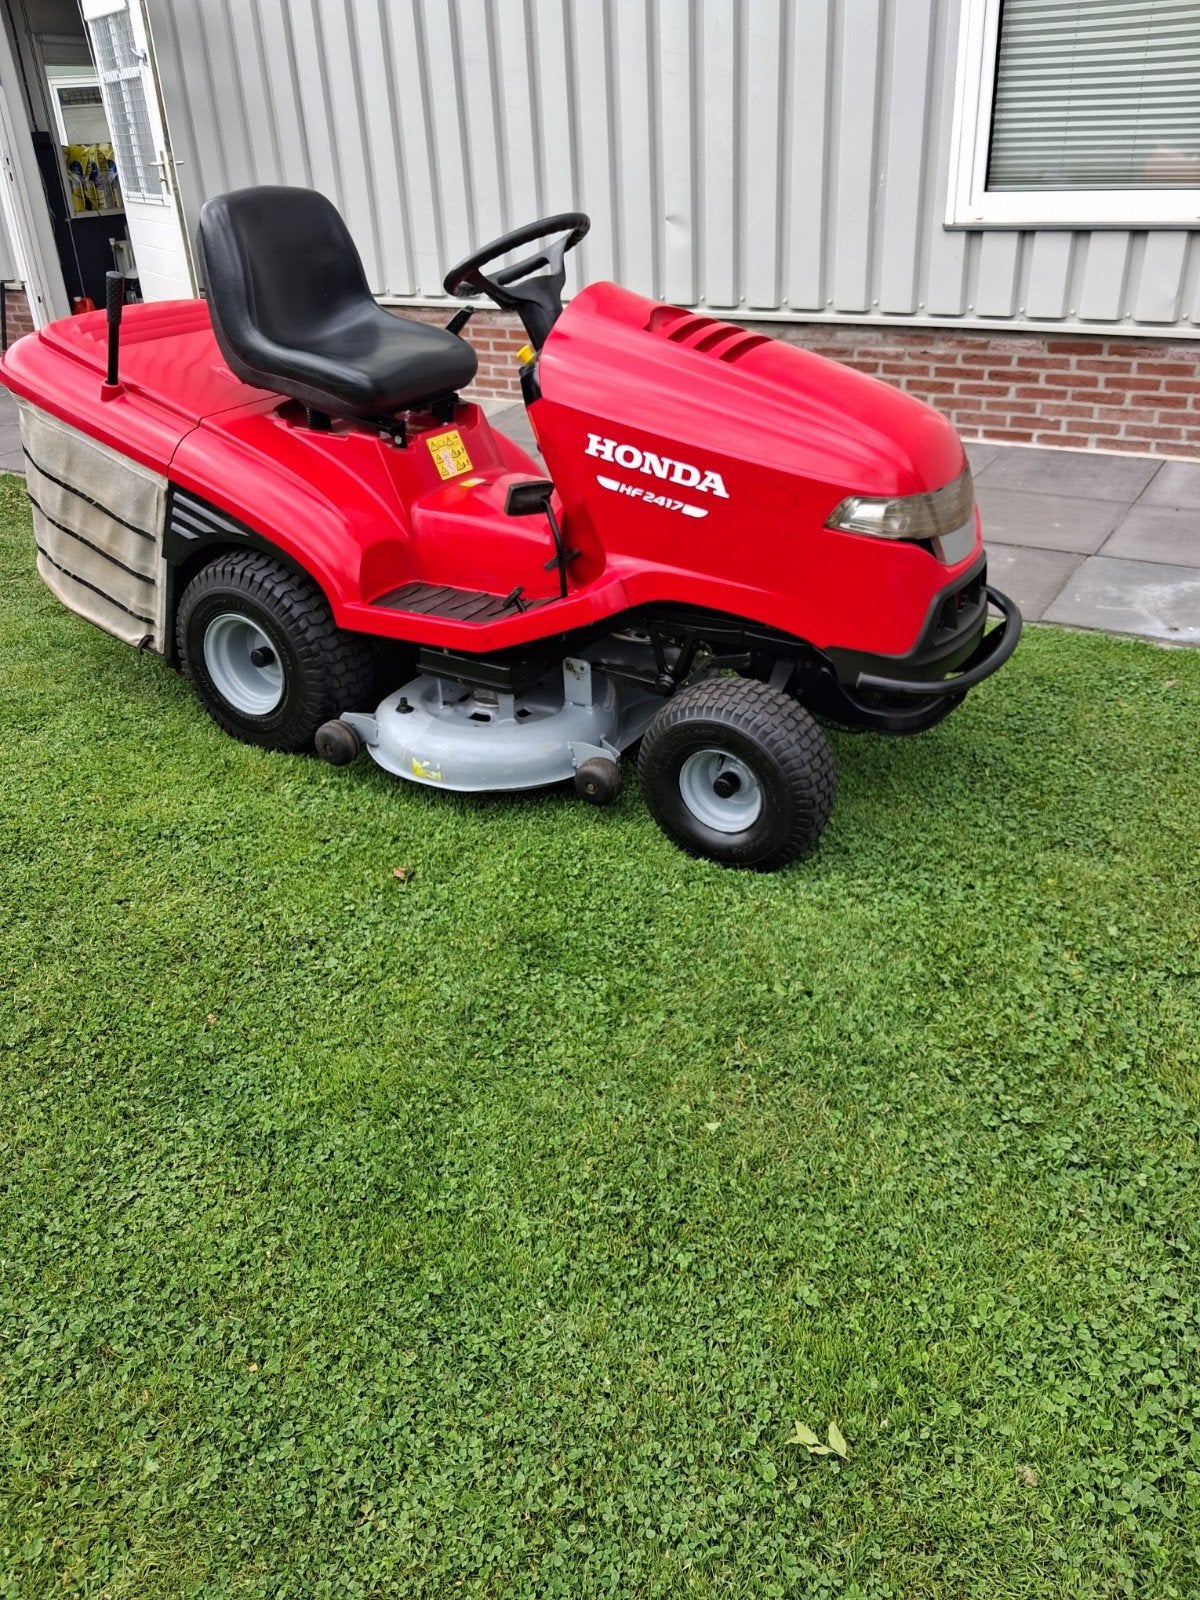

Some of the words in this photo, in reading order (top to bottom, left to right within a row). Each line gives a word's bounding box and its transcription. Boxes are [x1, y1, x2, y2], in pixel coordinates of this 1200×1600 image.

[584, 433, 730, 498] HONDA
[619, 483, 643, 497] HF
[642, 491, 684, 511] 2417
